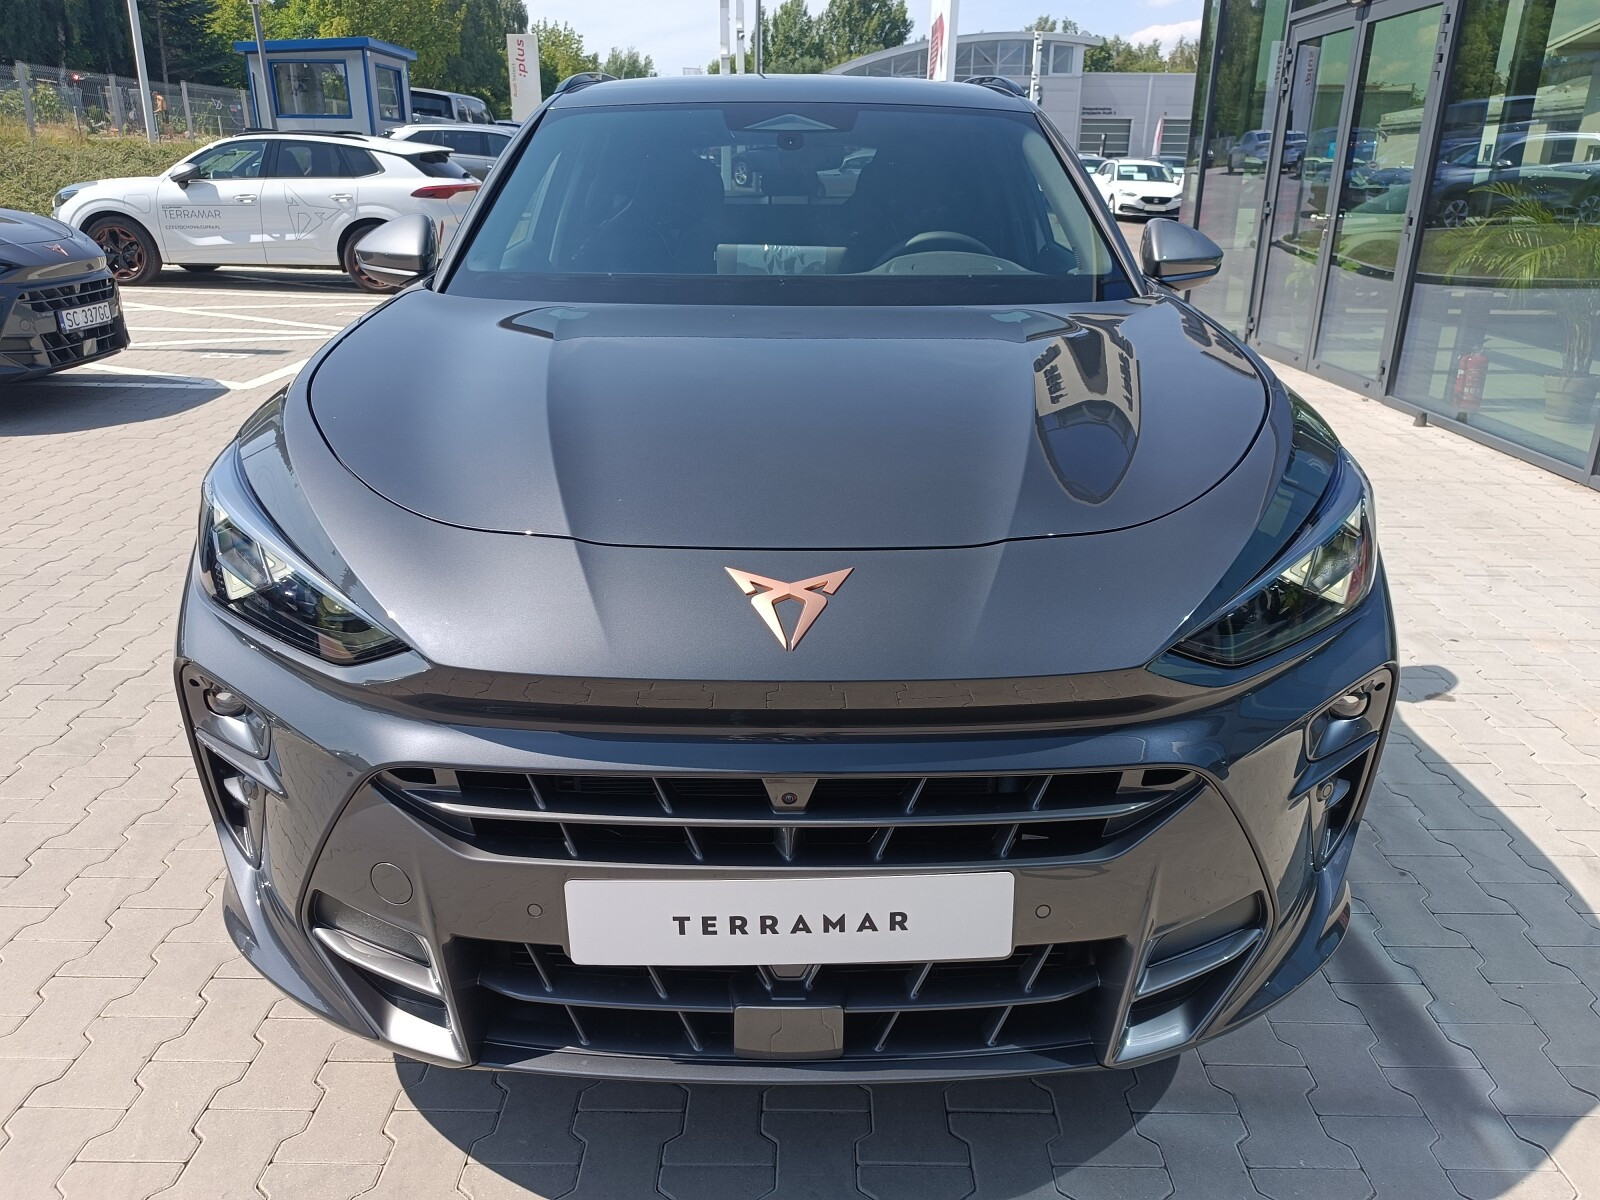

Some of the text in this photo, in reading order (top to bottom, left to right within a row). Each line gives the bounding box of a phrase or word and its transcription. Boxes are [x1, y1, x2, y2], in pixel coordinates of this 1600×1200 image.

[516, 39, 528, 78] :plus
[162, 209, 222, 219] TERRAMAR
[65, 304, 110, 328] SC 337GC
[672, 911, 909, 936] TERRAMAR
